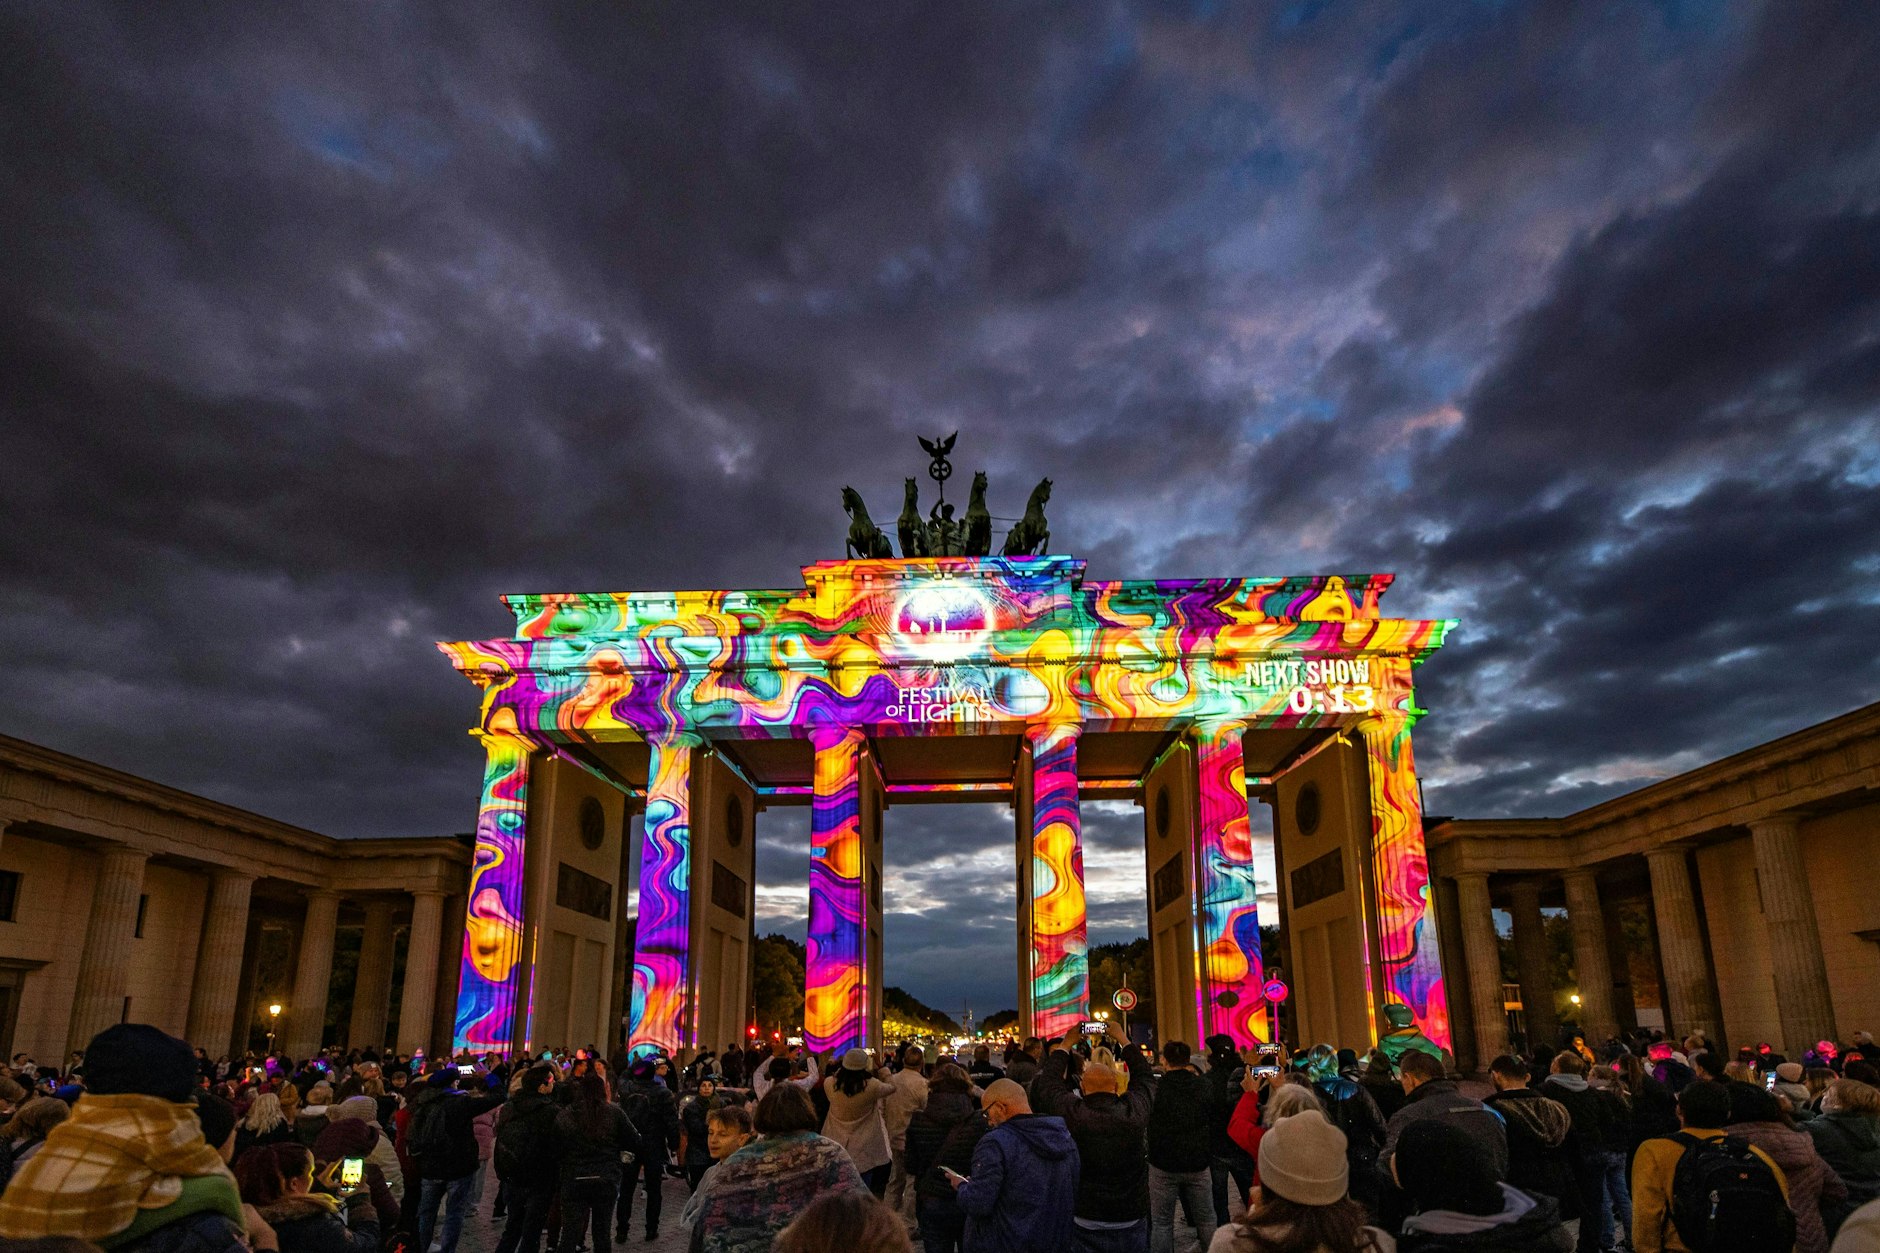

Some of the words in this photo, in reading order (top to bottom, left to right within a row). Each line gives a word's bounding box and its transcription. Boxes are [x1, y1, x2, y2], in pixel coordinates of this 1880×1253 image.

[1245, 660, 1301, 686] NEXT
[1306, 659, 1369, 684] SHOW
[899, 686, 990, 704] FESTIVAL
[1289, 685, 1374, 713] 0:13
[885, 705, 905, 717] OF
[908, 703, 992, 722] LIGHTS
